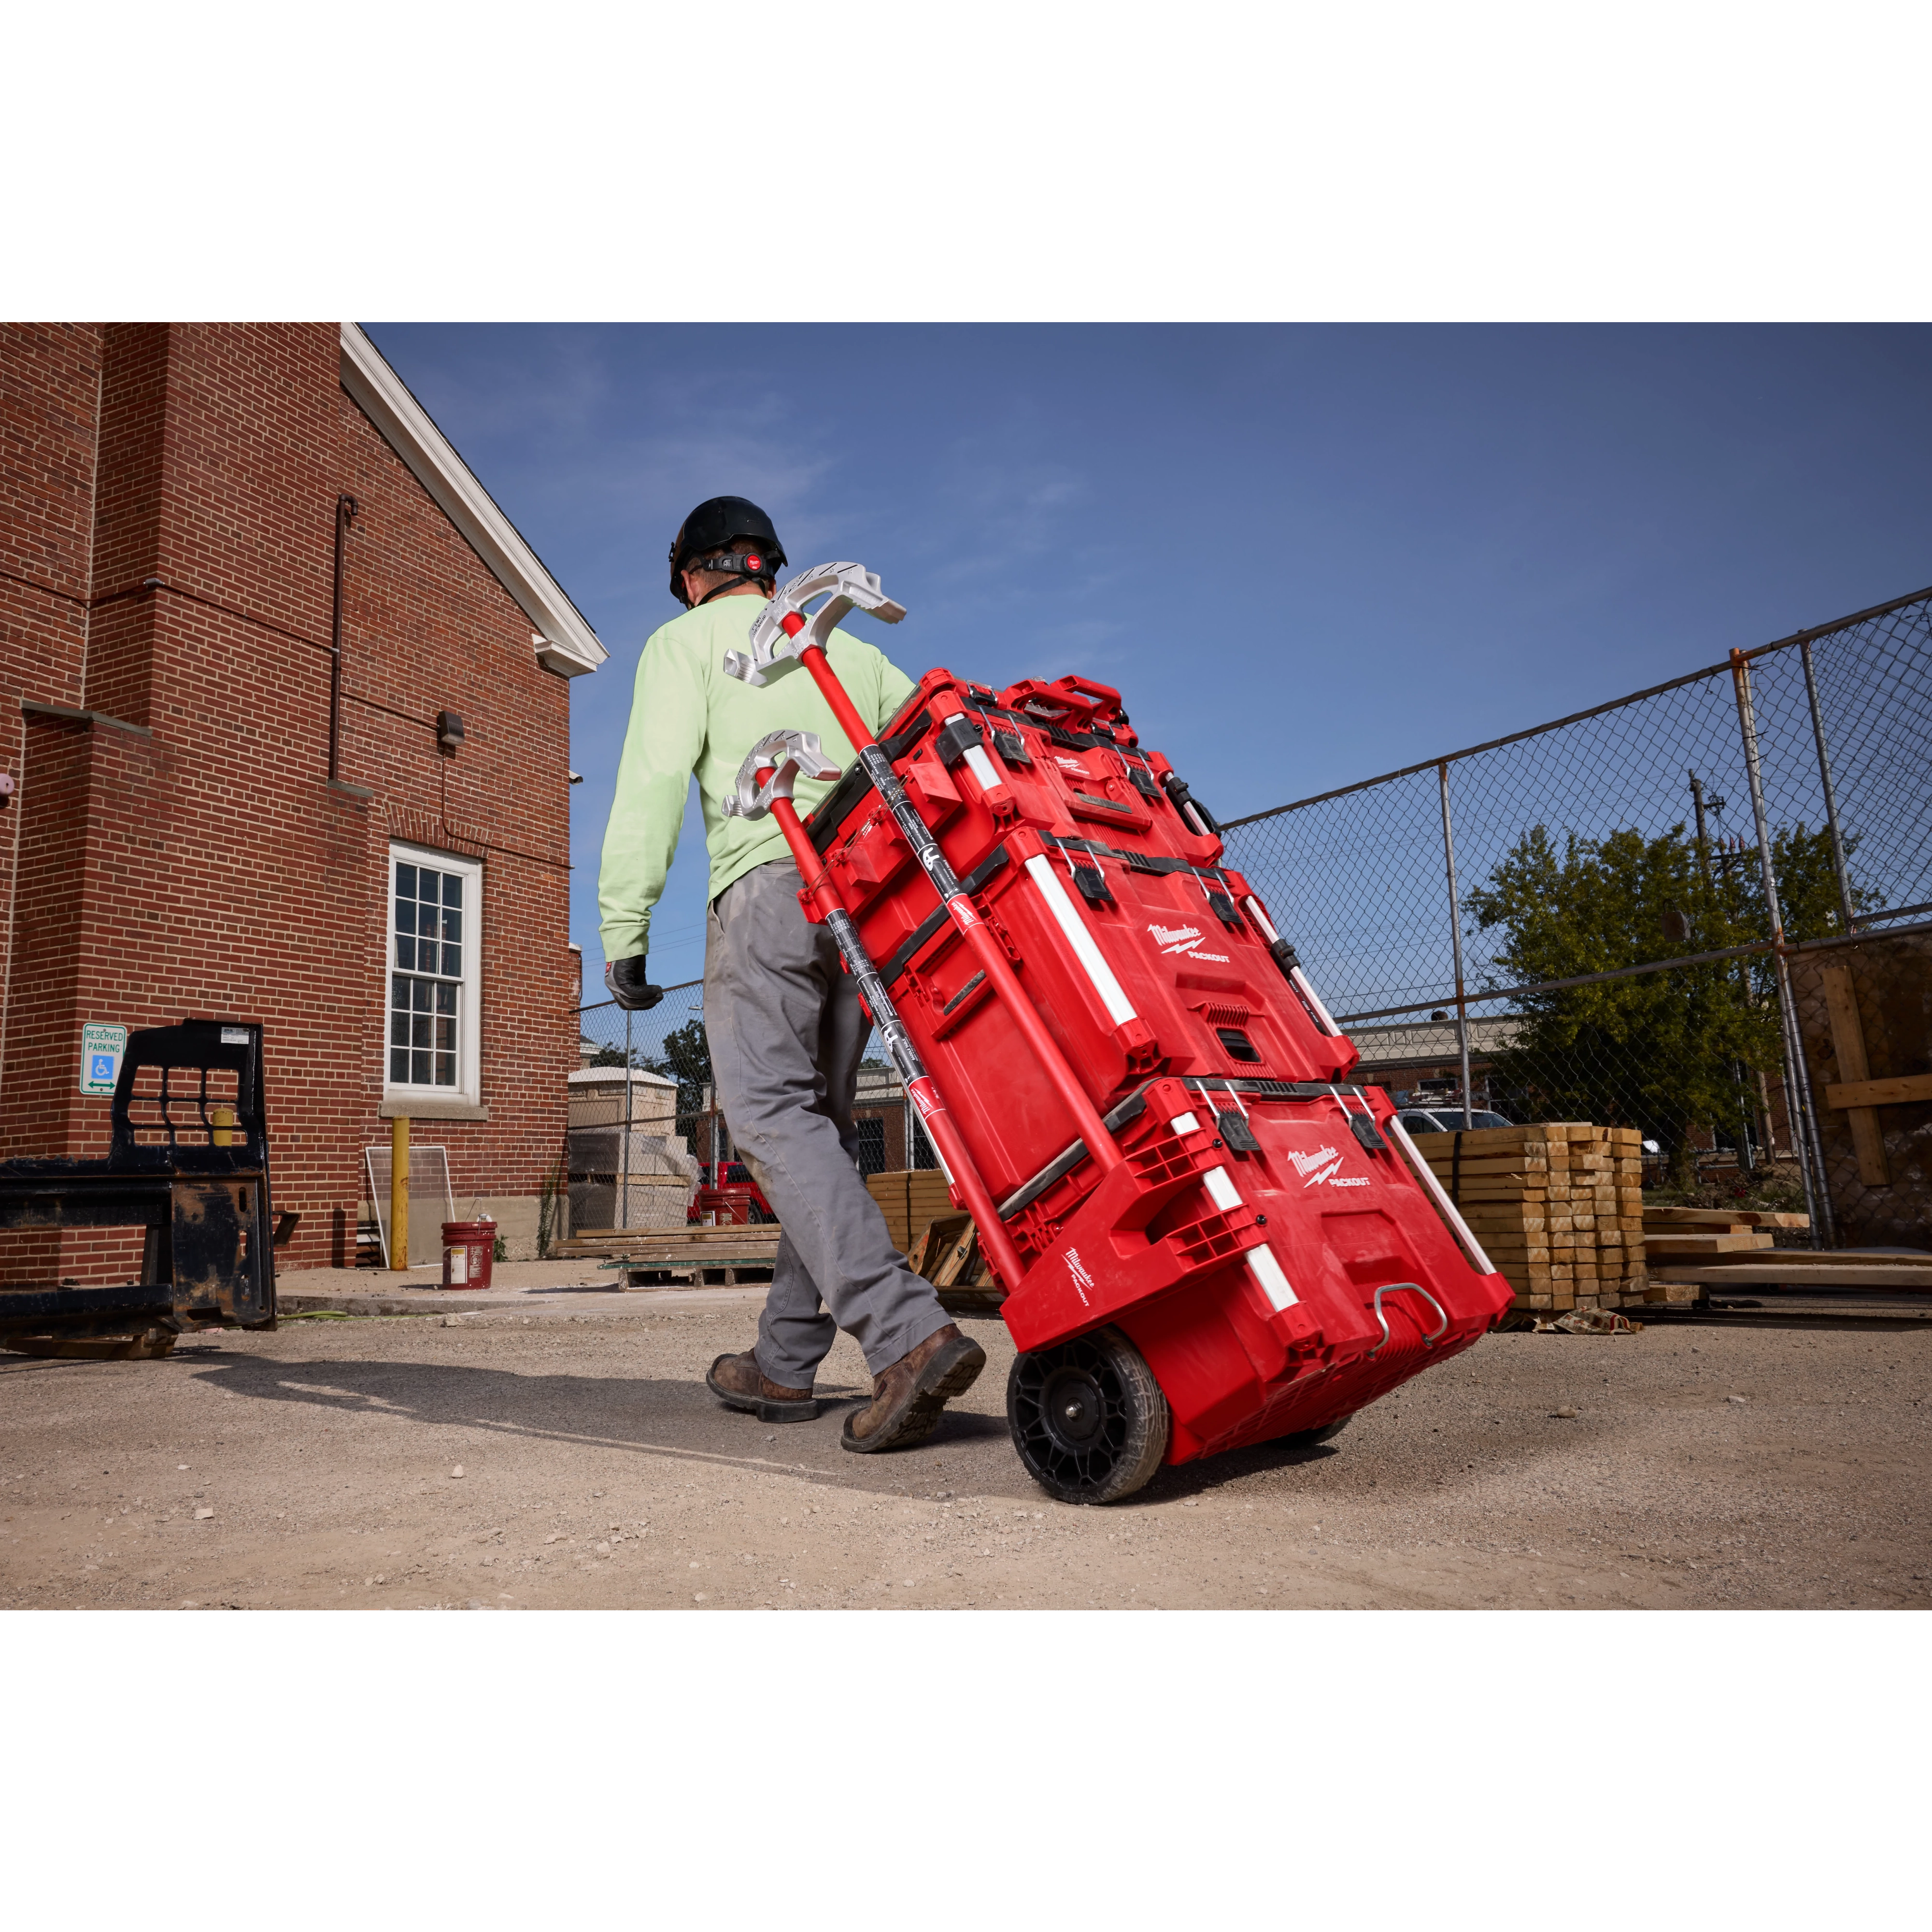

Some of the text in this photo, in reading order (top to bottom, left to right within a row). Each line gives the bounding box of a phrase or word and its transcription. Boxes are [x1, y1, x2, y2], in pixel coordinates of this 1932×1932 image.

[951, 901, 974, 925] Milwaukee
[1147, 924, 1201, 946] Milwaukee
[1187, 951, 1230, 963] PACKOUT
[86, 1030, 123, 1041] RESERVED
[88, 1042, 120, 1052] PARKING
[910, 1088, 930, 1114] Milwaukee
[1287, 1145, 1339, 1178] Milwaukee
[1328, 1177, 1370, 1187] PACKOUT
[1065, 1247, 1094, 1288] Milwaukee
[1071, 1274, 1090, 1307] PACKOUT
